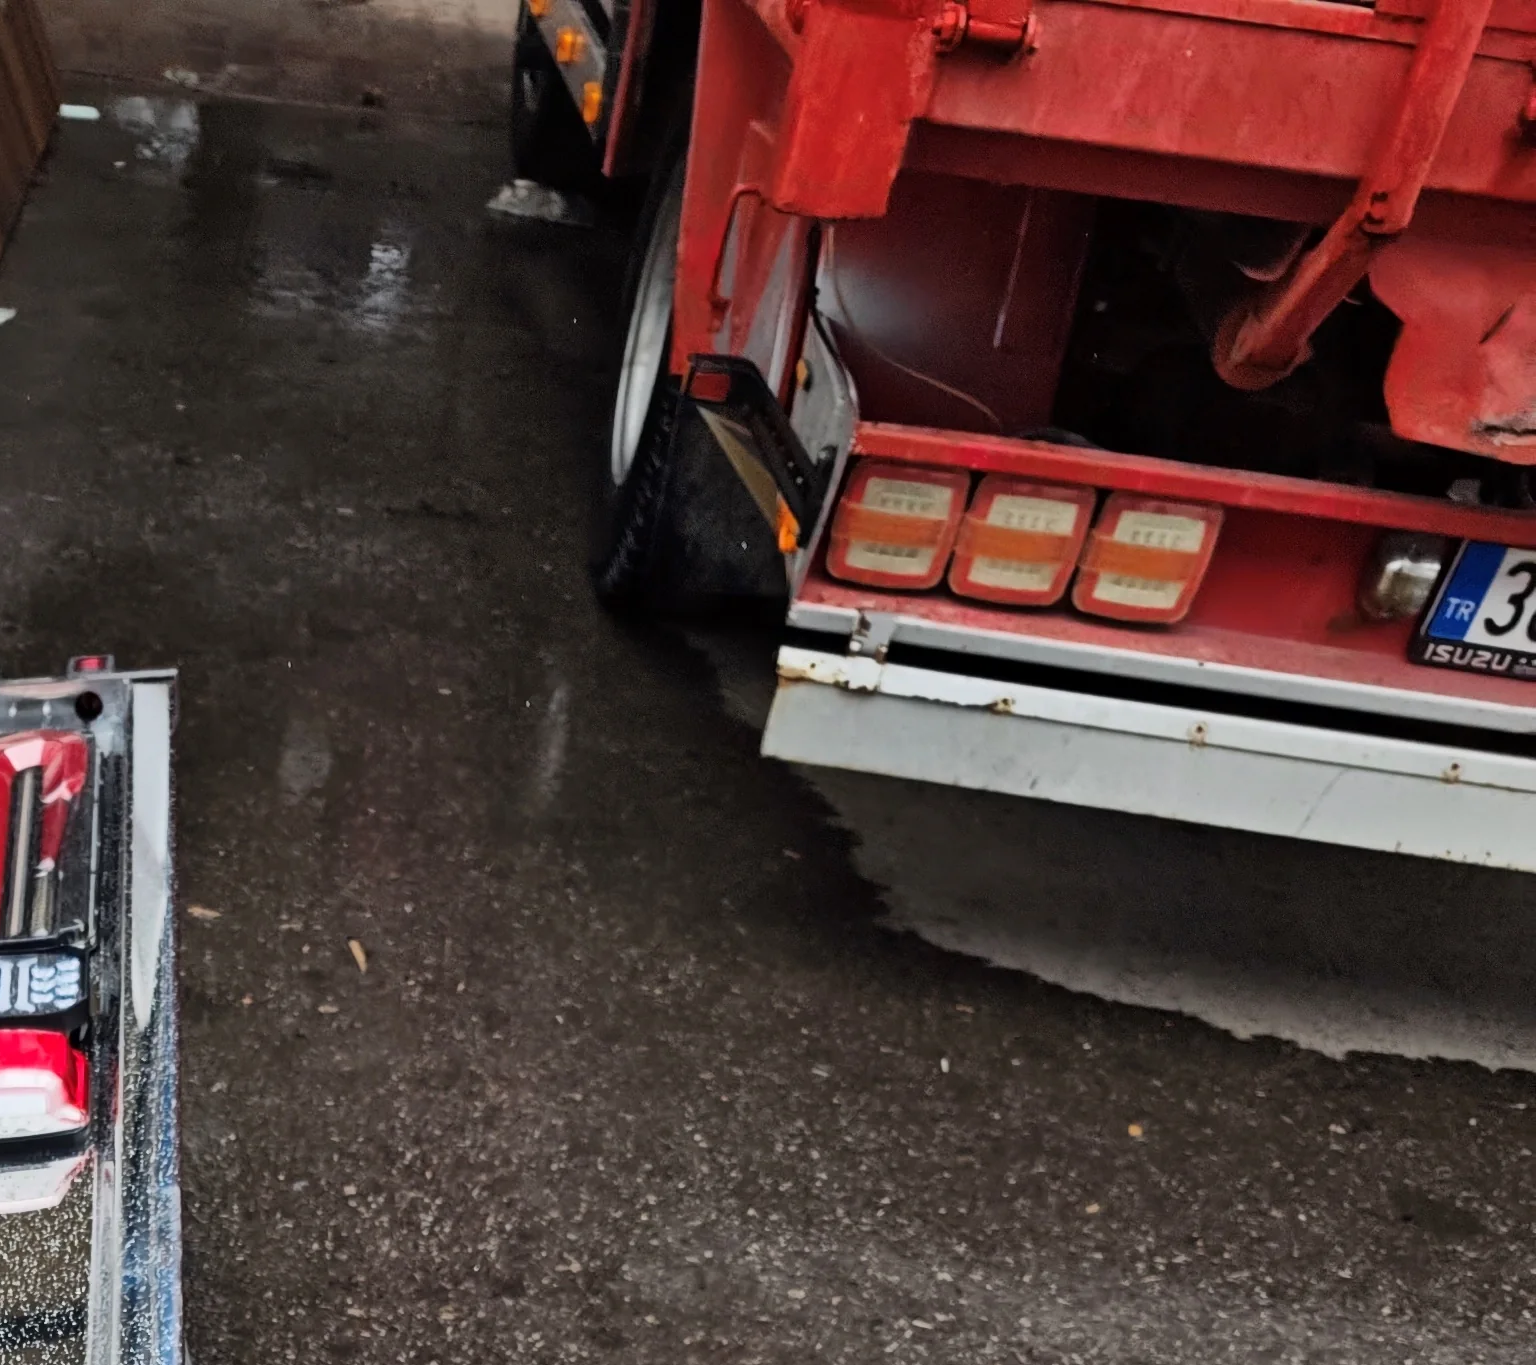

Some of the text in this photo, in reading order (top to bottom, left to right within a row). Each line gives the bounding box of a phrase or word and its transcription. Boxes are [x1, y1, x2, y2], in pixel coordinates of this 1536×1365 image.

[1446, 597, 1475, 621] TR
[1483, 561, 1536, 643] 3
[1423, 643, 1512, 671] ISUZU
